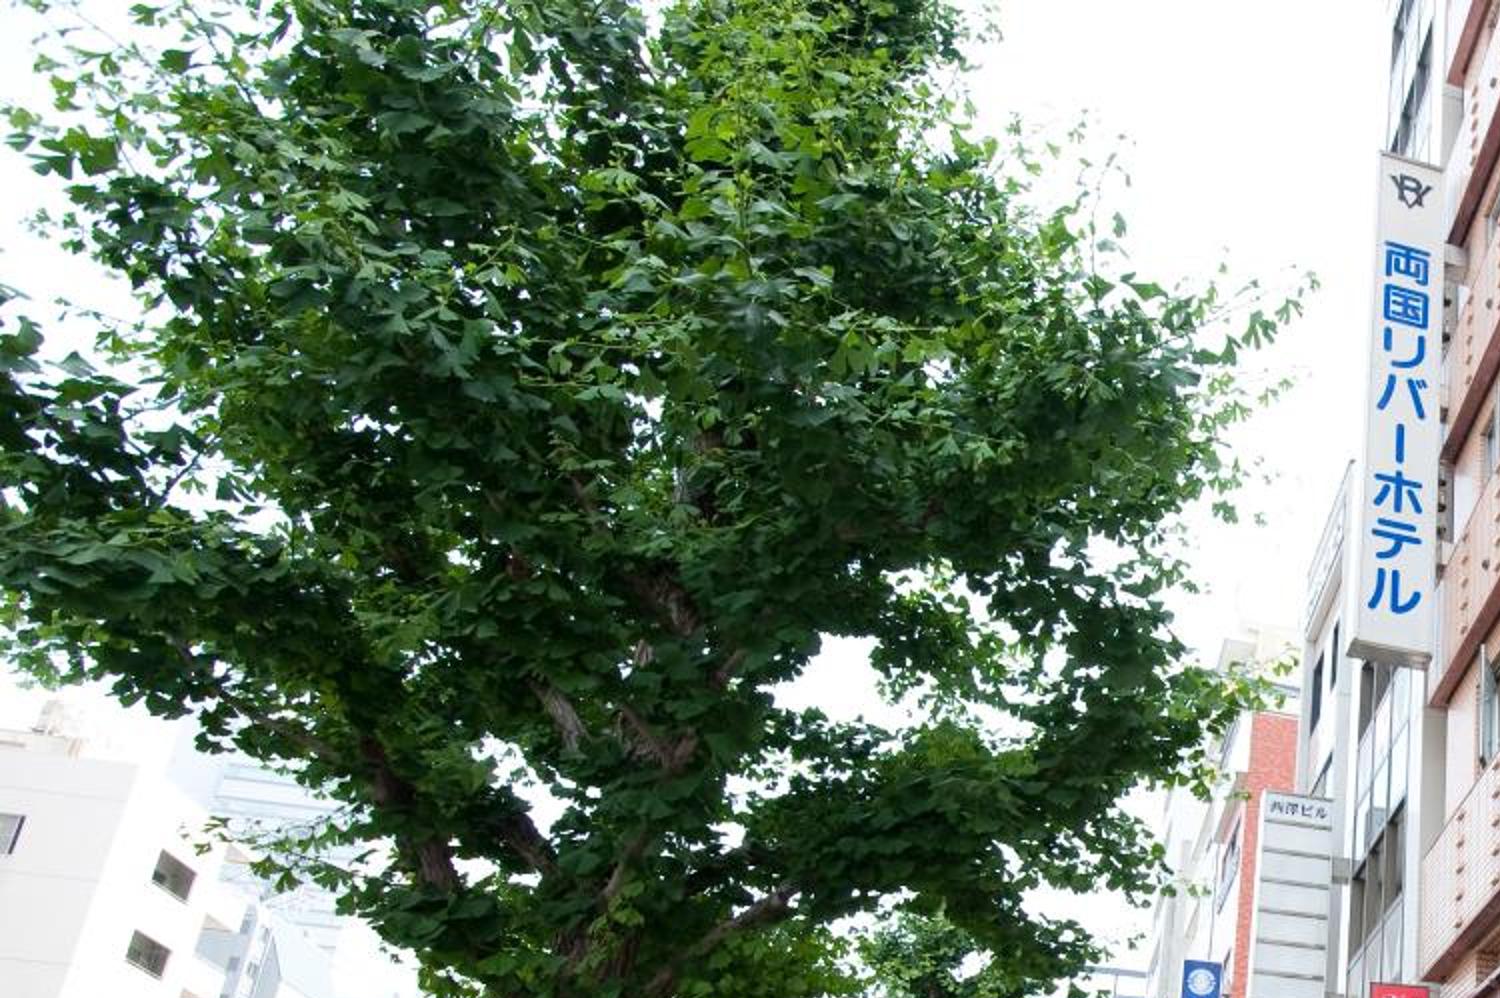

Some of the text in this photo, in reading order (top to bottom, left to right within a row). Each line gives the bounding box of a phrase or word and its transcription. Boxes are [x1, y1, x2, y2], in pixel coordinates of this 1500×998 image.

[1367, 240, 1431, 614] 両国リバーホテル
